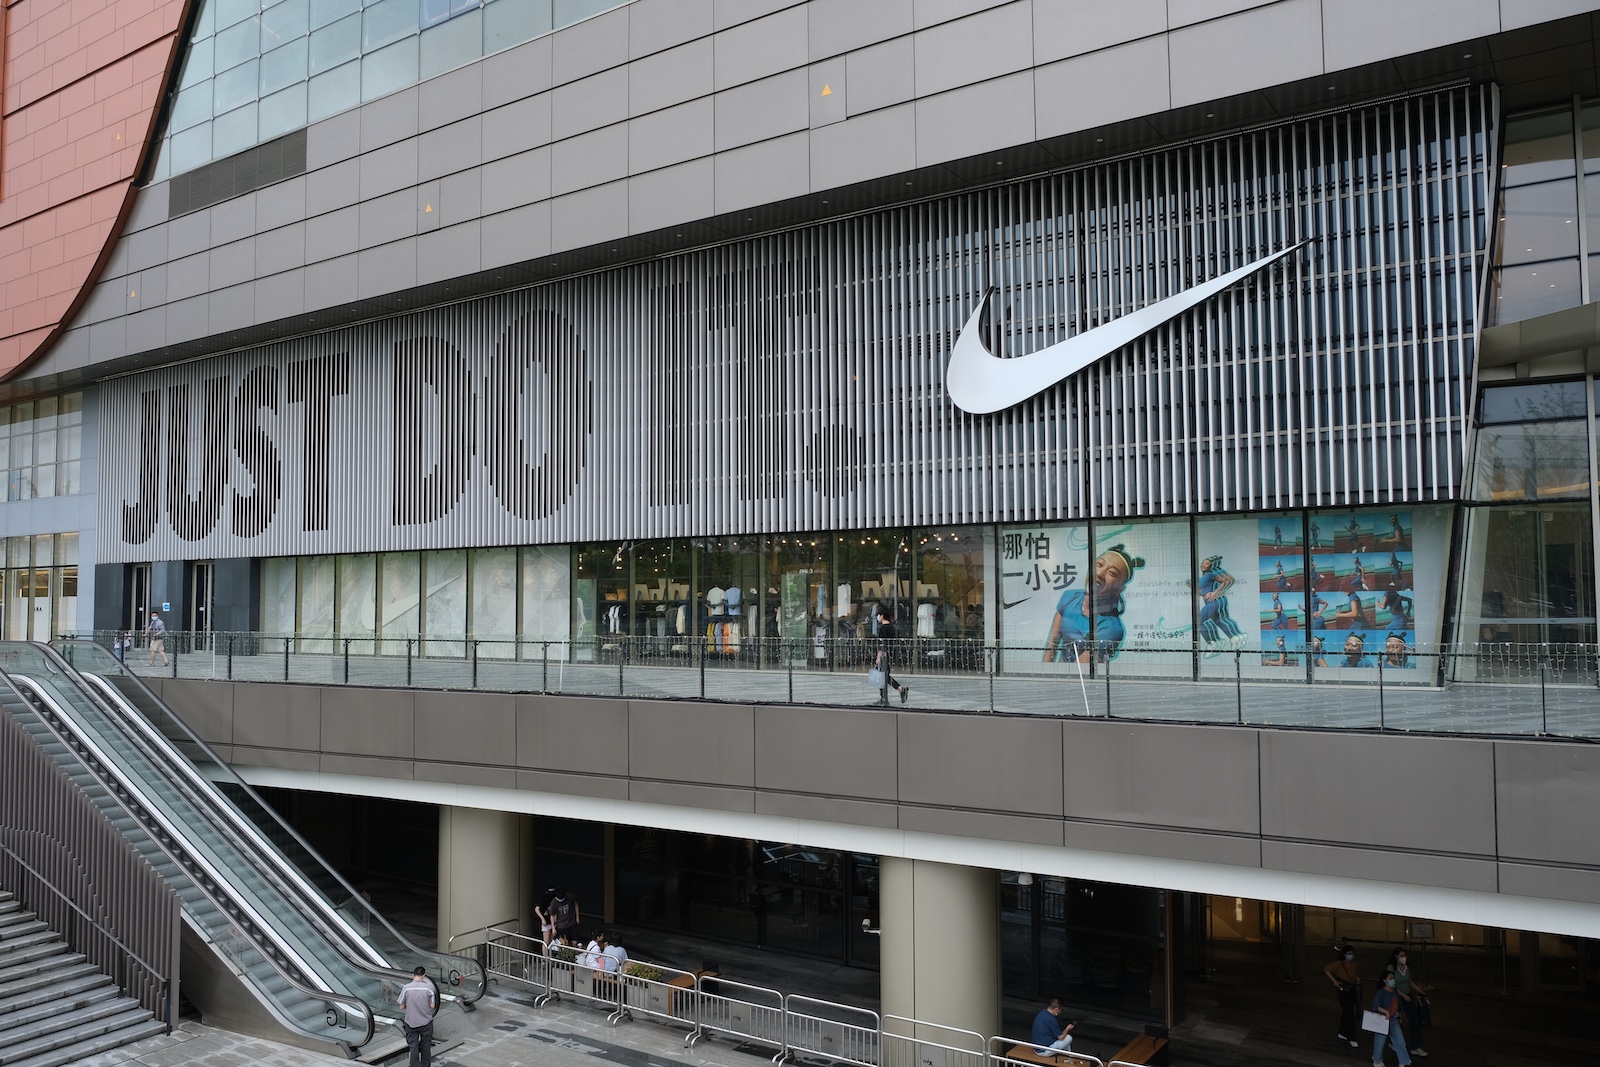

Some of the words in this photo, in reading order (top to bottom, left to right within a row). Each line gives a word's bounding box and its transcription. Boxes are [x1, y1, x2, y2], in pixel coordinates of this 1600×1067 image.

[122, 351, 349, 545] JUST
[392, 309, 593, 527] DO
[1002, 532, 1050, 560] 哪怕
[1002, 563, 1078, 591] 一小步
[441, 967, 460, 986] LG
